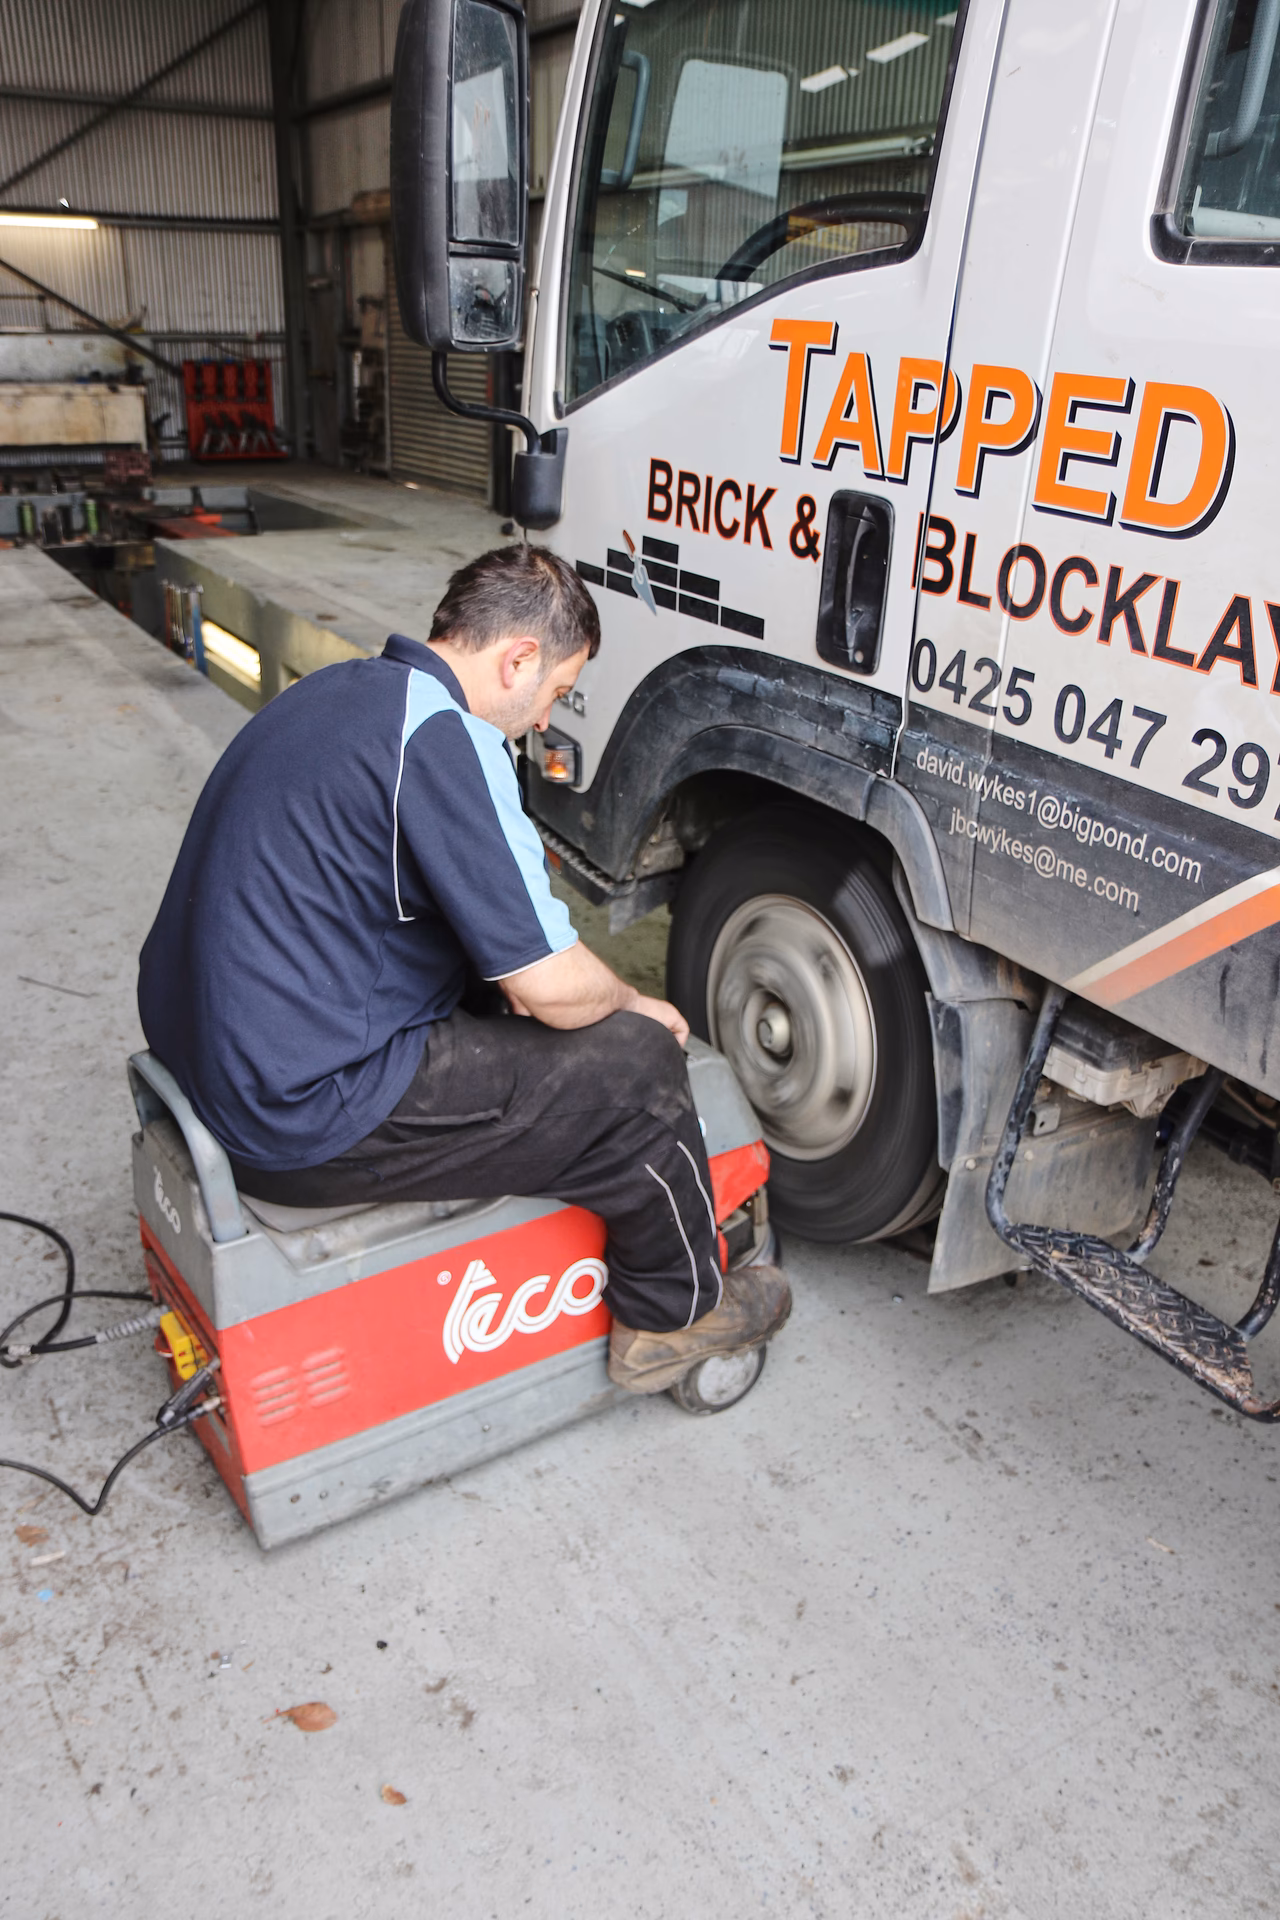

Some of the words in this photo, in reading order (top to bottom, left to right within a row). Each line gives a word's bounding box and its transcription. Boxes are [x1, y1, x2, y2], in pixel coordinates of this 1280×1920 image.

[768, 318, 1236, 541] TAPPED
[647, 457, 778, 551] BRICK
[788, 493, 822, 564] &
[911, 638, 1036, 727] 0425
[1053, 684, 1168, 770] 047
[1181, 727, 1280, 822] 29
[915, 747, 1203, 884] david.wykes1@bigpond.com
[949, 806, 1140, 912] jbcwykes@me.com
